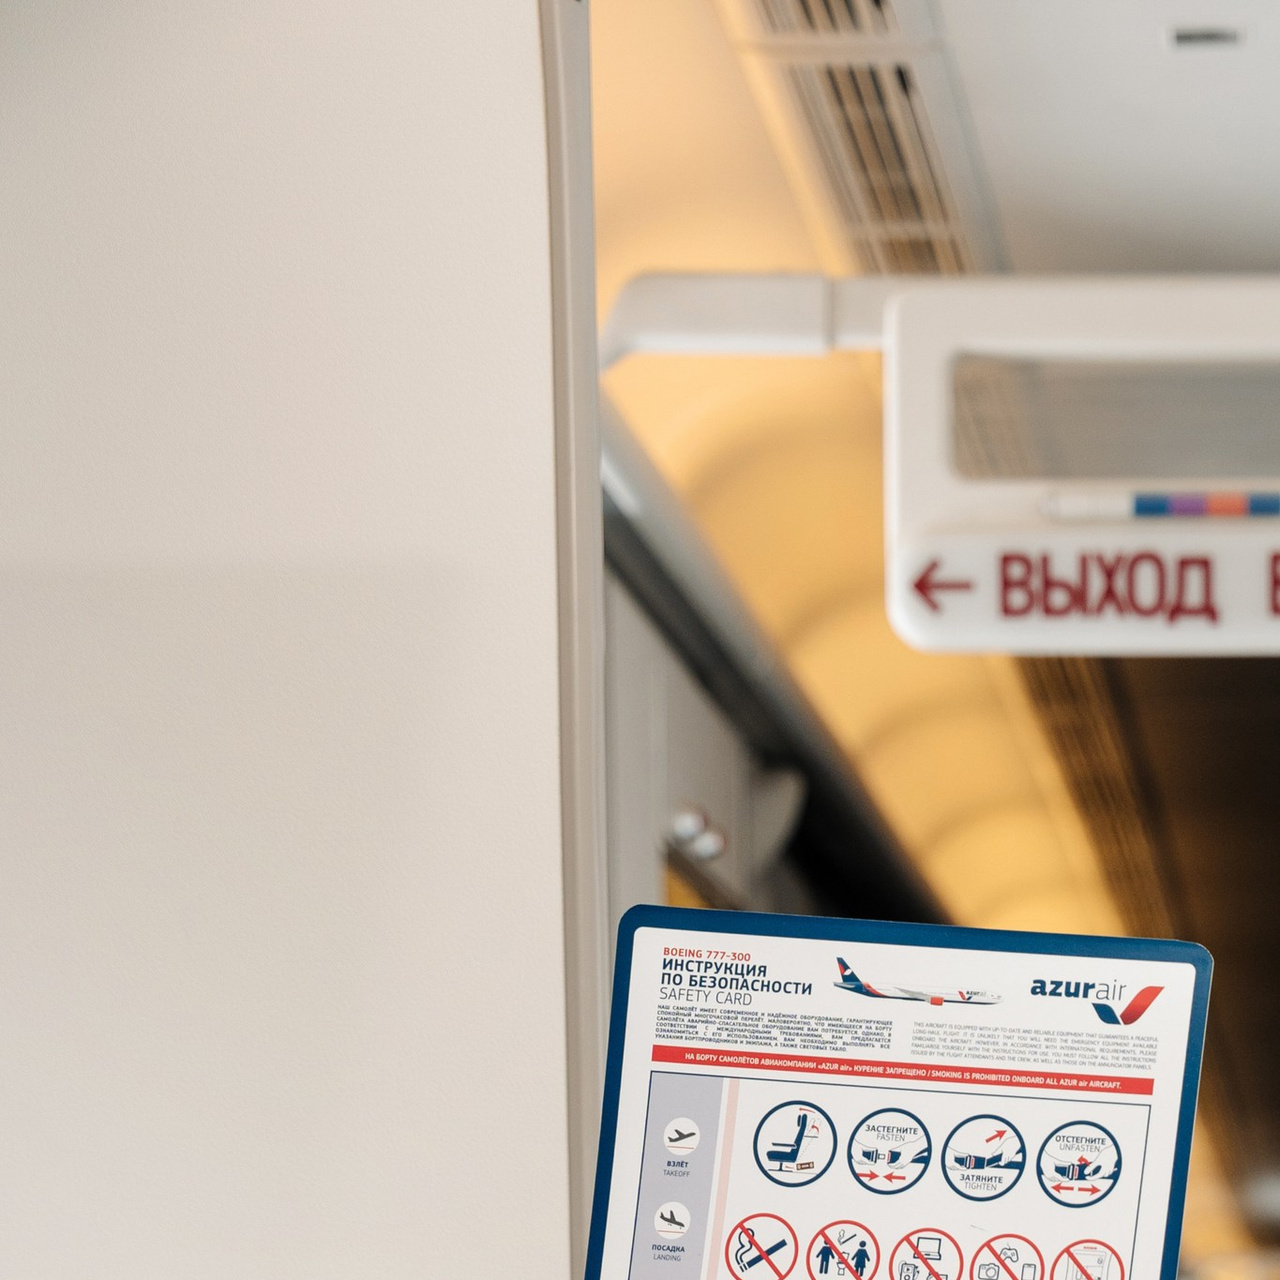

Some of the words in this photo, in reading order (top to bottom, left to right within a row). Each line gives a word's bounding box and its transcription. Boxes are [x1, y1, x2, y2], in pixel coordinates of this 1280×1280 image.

[1000, 551, 1221, 626] ВЫХОД
[663, 947, 702, 958] BOEING
[706, 950, 750, 961] 777-300
[661, 958, 767, 979] ИНСТРУКЦИЯ
[660, 972, 682, 986] ПО
[688, 974, 812, 995] БЕЗОПАСНОСТИ
[659, 986, 711, 1003] SAFETY
[715, 990, 752, 1006] CARD
[685, 1052, 694, 1060] НА
[696, 1053, 717, 1061] БОРТУ
[718, 1054, 759, 1064] САМОЛЁТОВ
[760, 1057, 816, 1068] АВИАКОМПАНИИ
[853, 1064, 883, 1073] КУРЕНИЕ
[886, 1066, 926, 1076] ЗАПРЕЩЕНО
[931, 1069, 962, 1078] SMOKING
[963, 1071, 970, 1079] IS
[971, 1072, 1010, 1081] PROHIBITED
[1012, 1074, 1044, 1084] ONBOARD
[1046, 1077, 1056, 1085] ALL
[1060, 1078, 1077, 1086] AZUR
[1078, 1079, 1087, 1087] air
[1089, 1080, 1121, 1089] AIRCRAFT.
[864, 1124, 918, 1135] ЗАСТЕГНИТЕ
[876, 1133, 905, 1142] FASTEN
[1055, 1135, 1106, 1145] ОТСТЕГНИТЕ
[1059, 1143, 1100, 1153] UNFASTEN
[663, 1169, 689, 1177] TAKEOFF
[959, 1173, 1003, 1184] ЗАТЯНИТЕ
[964, 1181, 997, 1191] TIGHTEN
[651, 1244, 685, 1253] ПОСАДКА
[653, 1253, 681, 1261] LANDING
